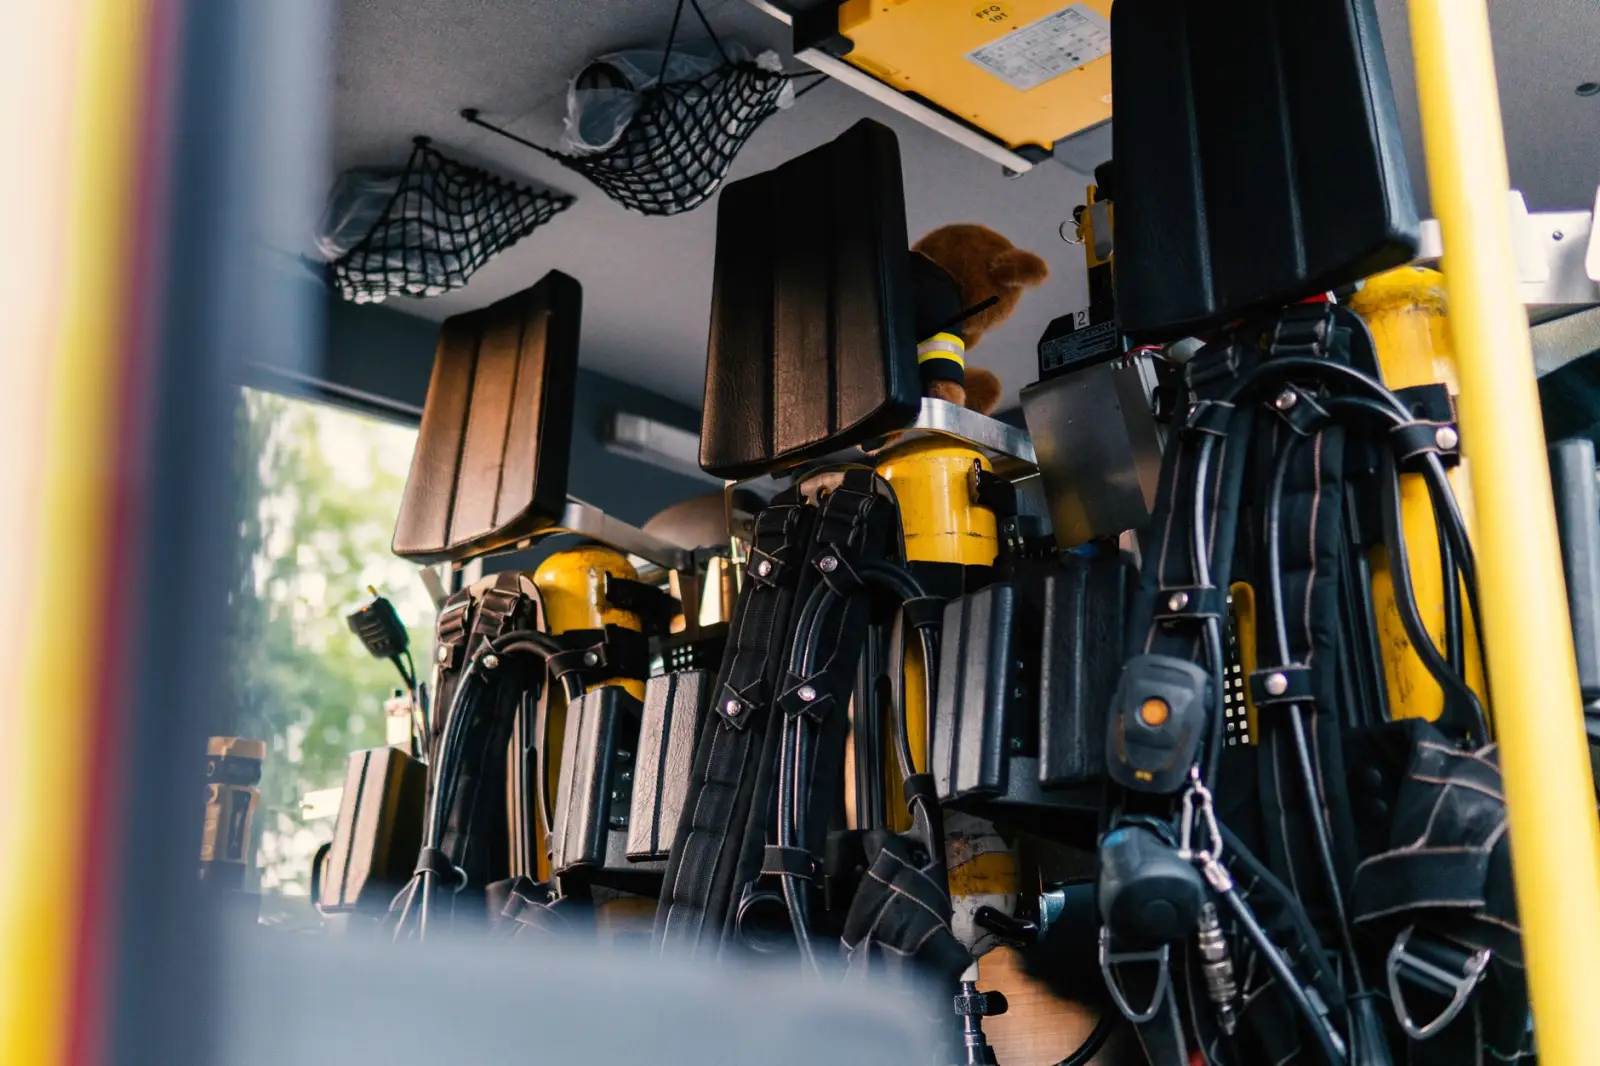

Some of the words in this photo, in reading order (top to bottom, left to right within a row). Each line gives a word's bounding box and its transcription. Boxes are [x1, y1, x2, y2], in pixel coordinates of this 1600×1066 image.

[975, 5, 1001, 19] FFG
[988, 12, 1008, 23] 101
[1077, 310, 1087, 327] 2
